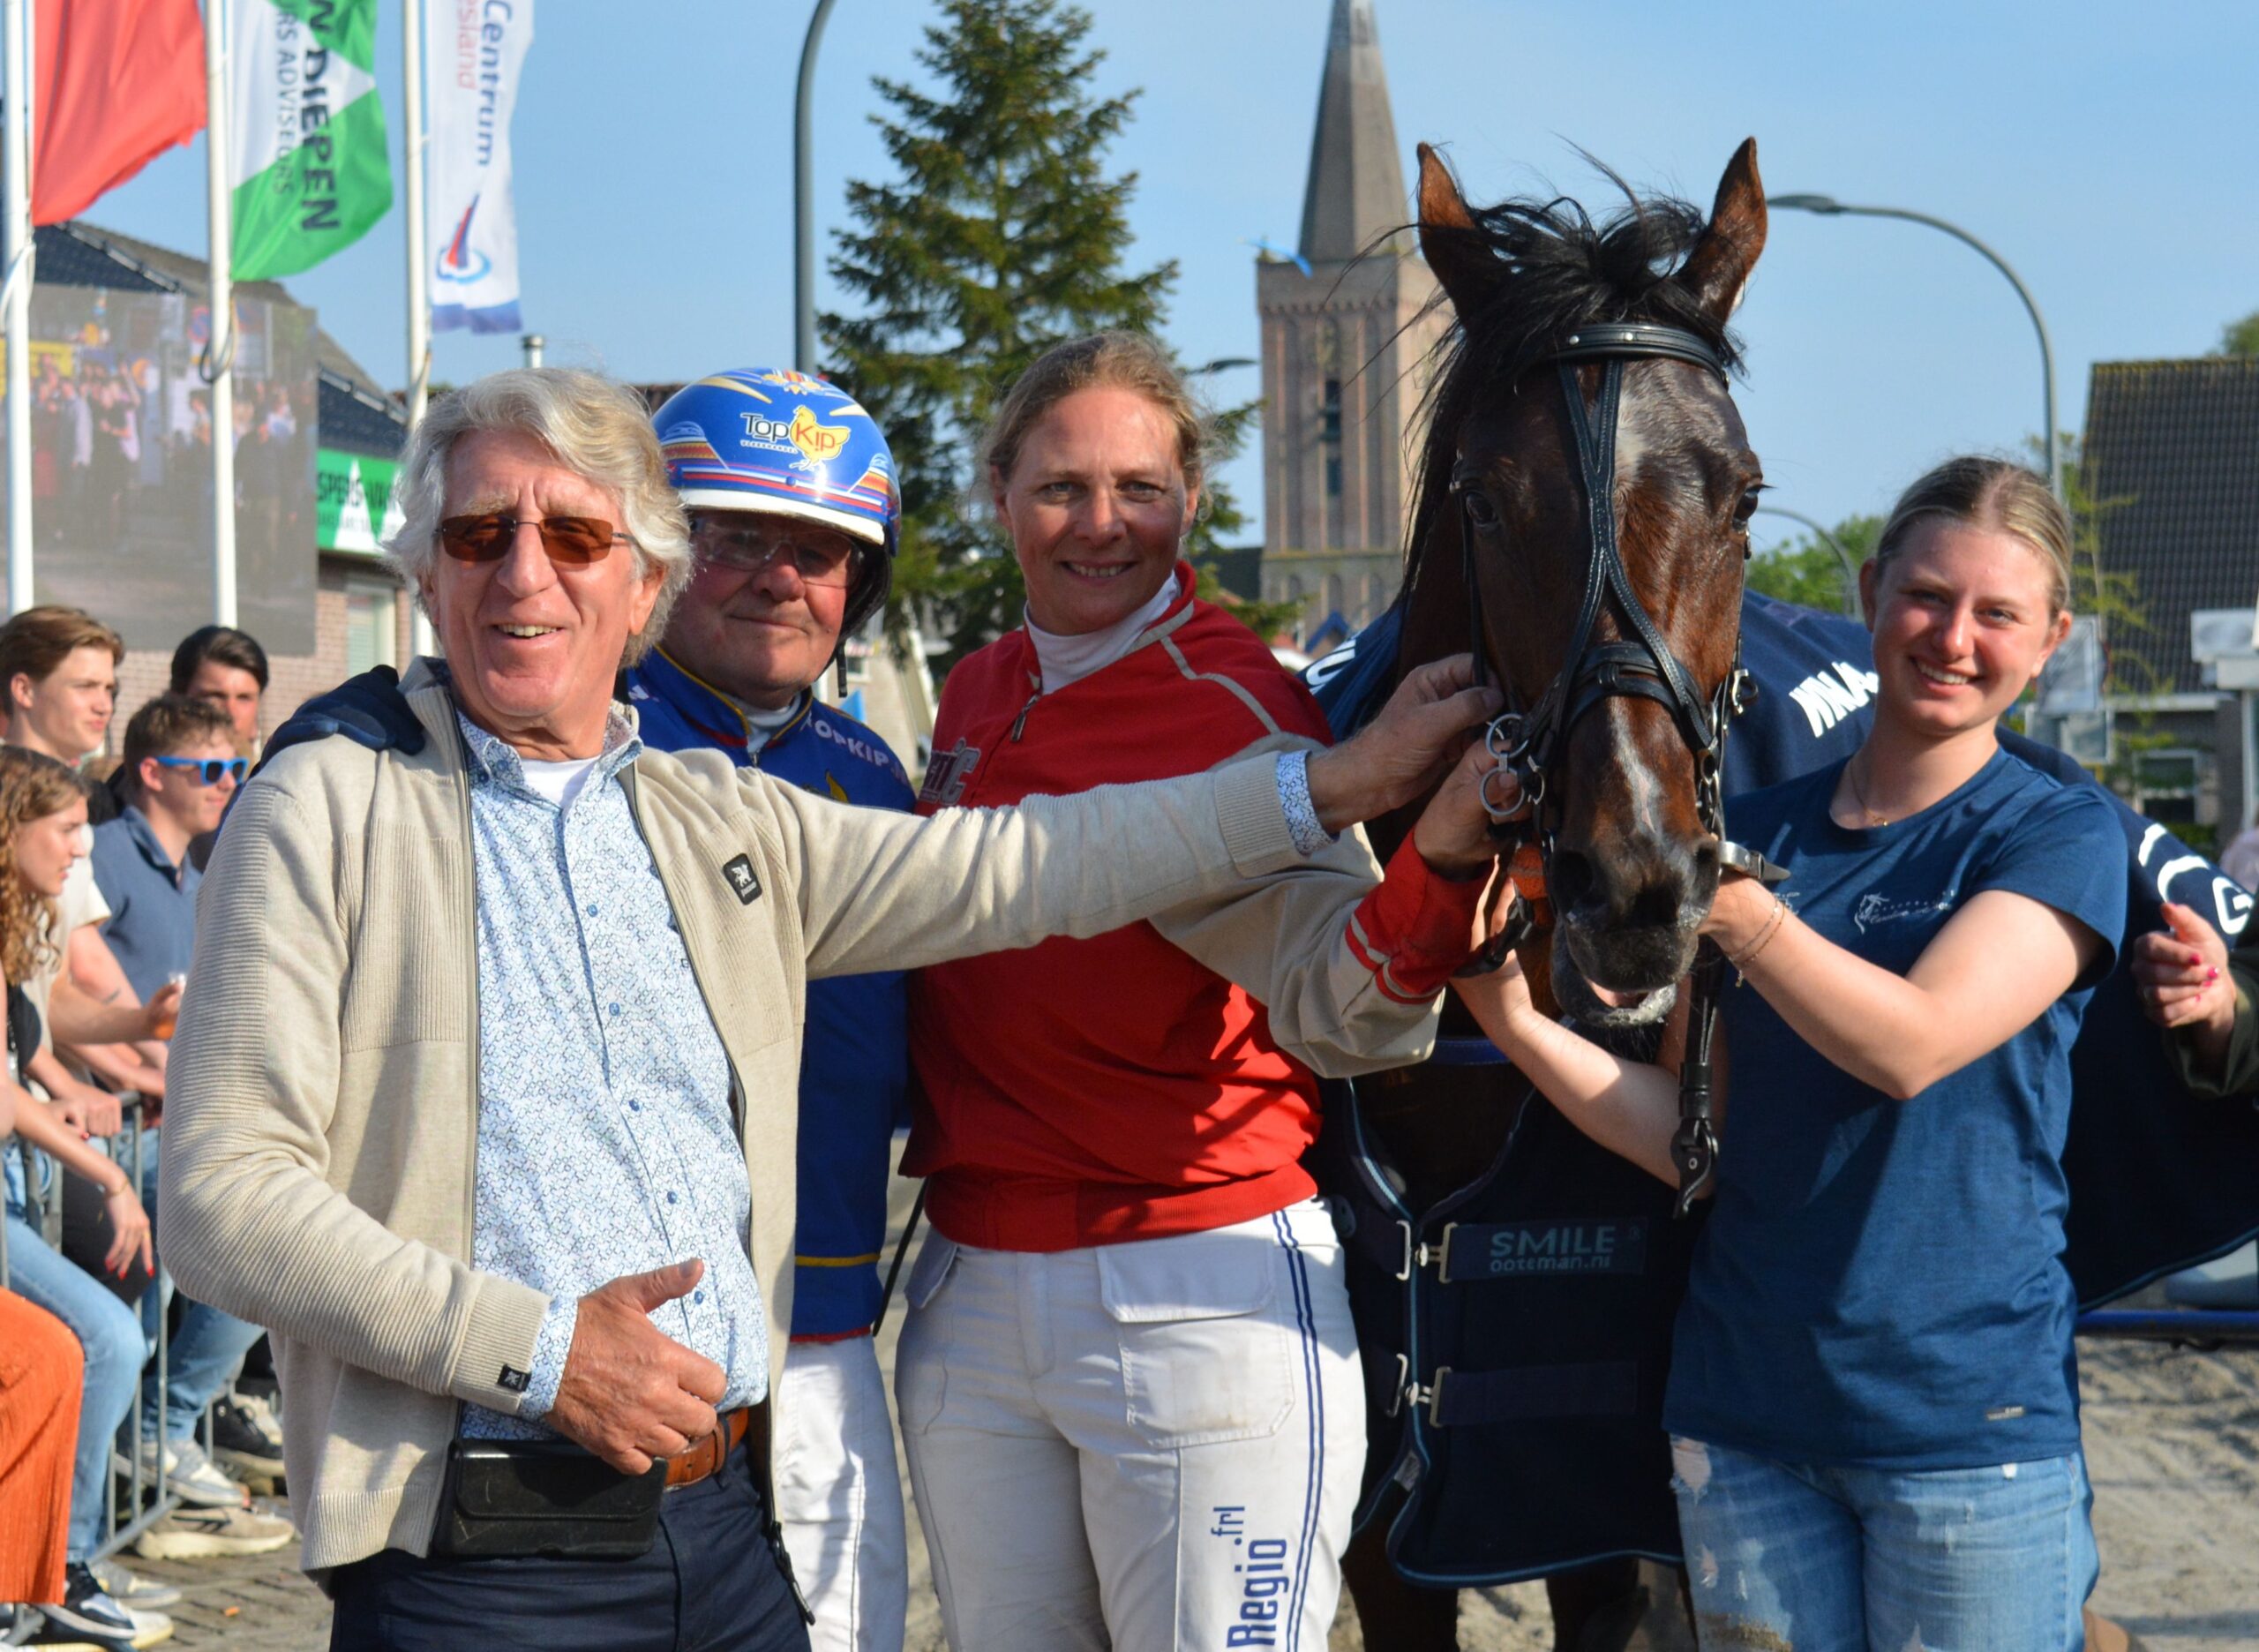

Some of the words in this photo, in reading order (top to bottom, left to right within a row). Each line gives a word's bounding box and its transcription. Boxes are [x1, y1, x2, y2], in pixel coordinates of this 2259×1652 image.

[272, 49, 298, 195] ADVISEURS
[301, 49, 341, 230] DIEPEN
[477, 0, 512, 167] Centrum
[1490, 1226, 1617, 1258] SMILE
[1227, 1538, 1289, 1648] Regio
